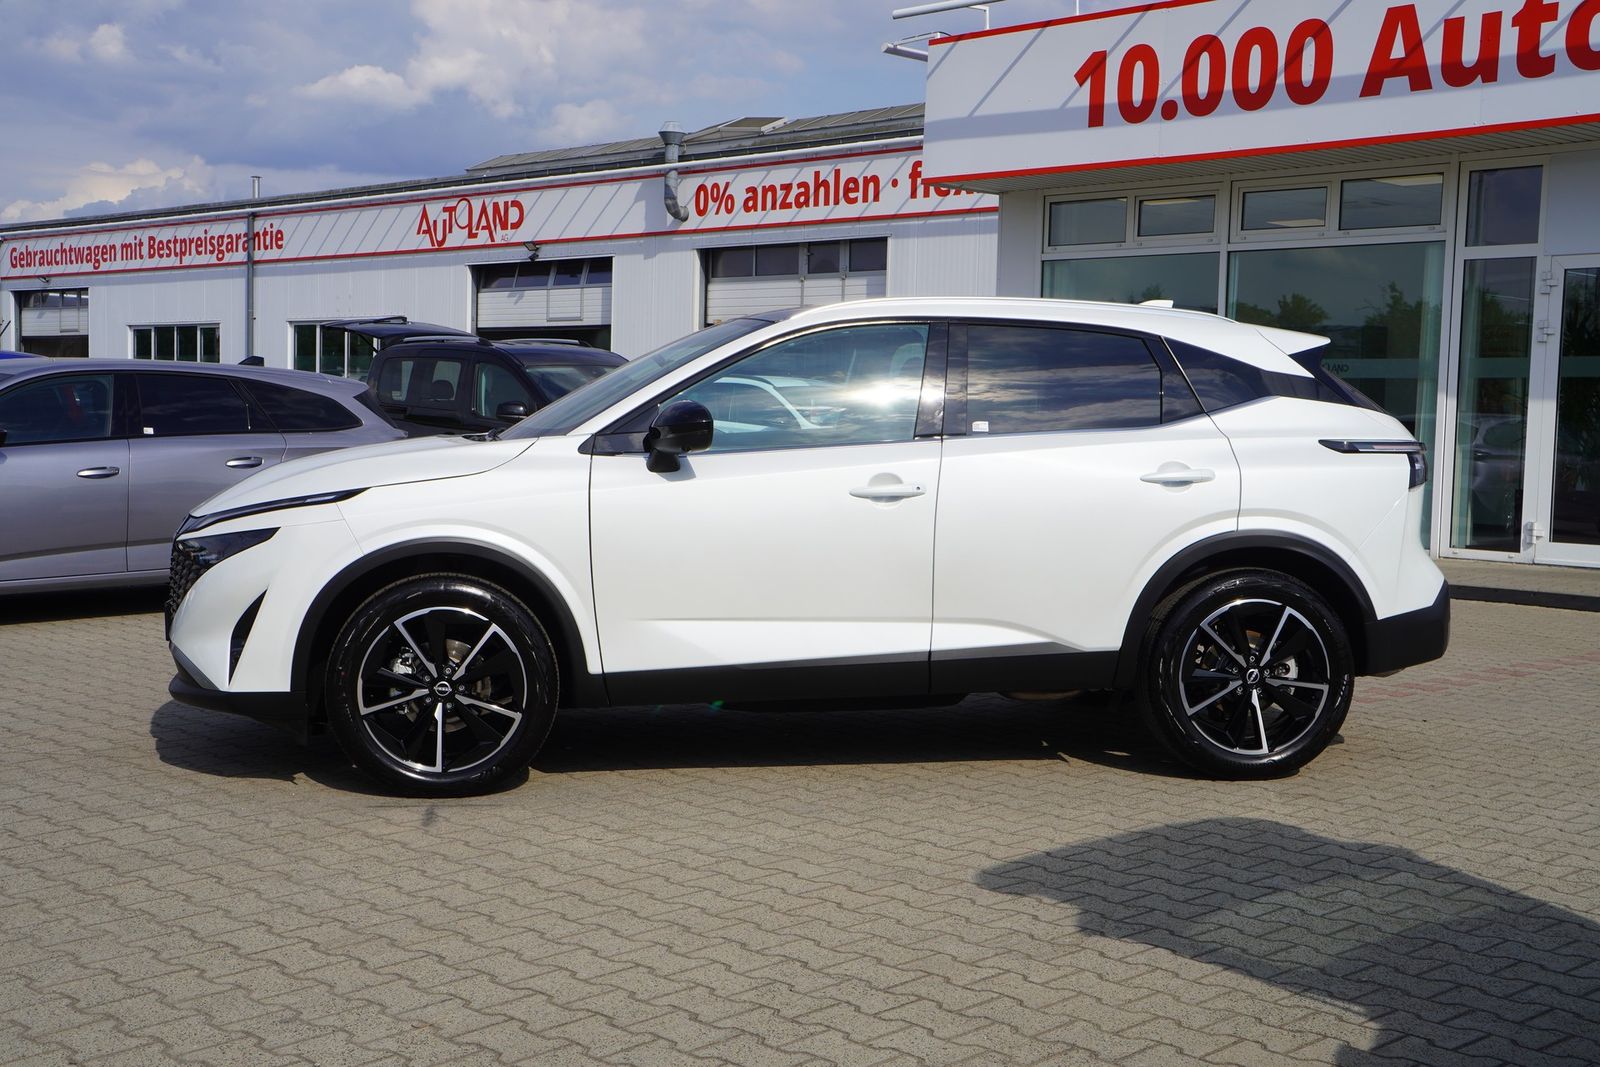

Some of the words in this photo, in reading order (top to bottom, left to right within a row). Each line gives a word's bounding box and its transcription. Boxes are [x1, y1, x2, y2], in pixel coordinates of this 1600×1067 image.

[1073, 18, 1334, 128] 10.000
[694, 181, 735, 218] 0%
[742, 168, 881, 214] anzahlen
[10, 241, 117, 270] Gebrauchtwagen
[121, 235, 144, 261] mit
[147, 222, 284, 265] Bestpreisgarantie
[416, 197, 525, 248] AUTOLAND
